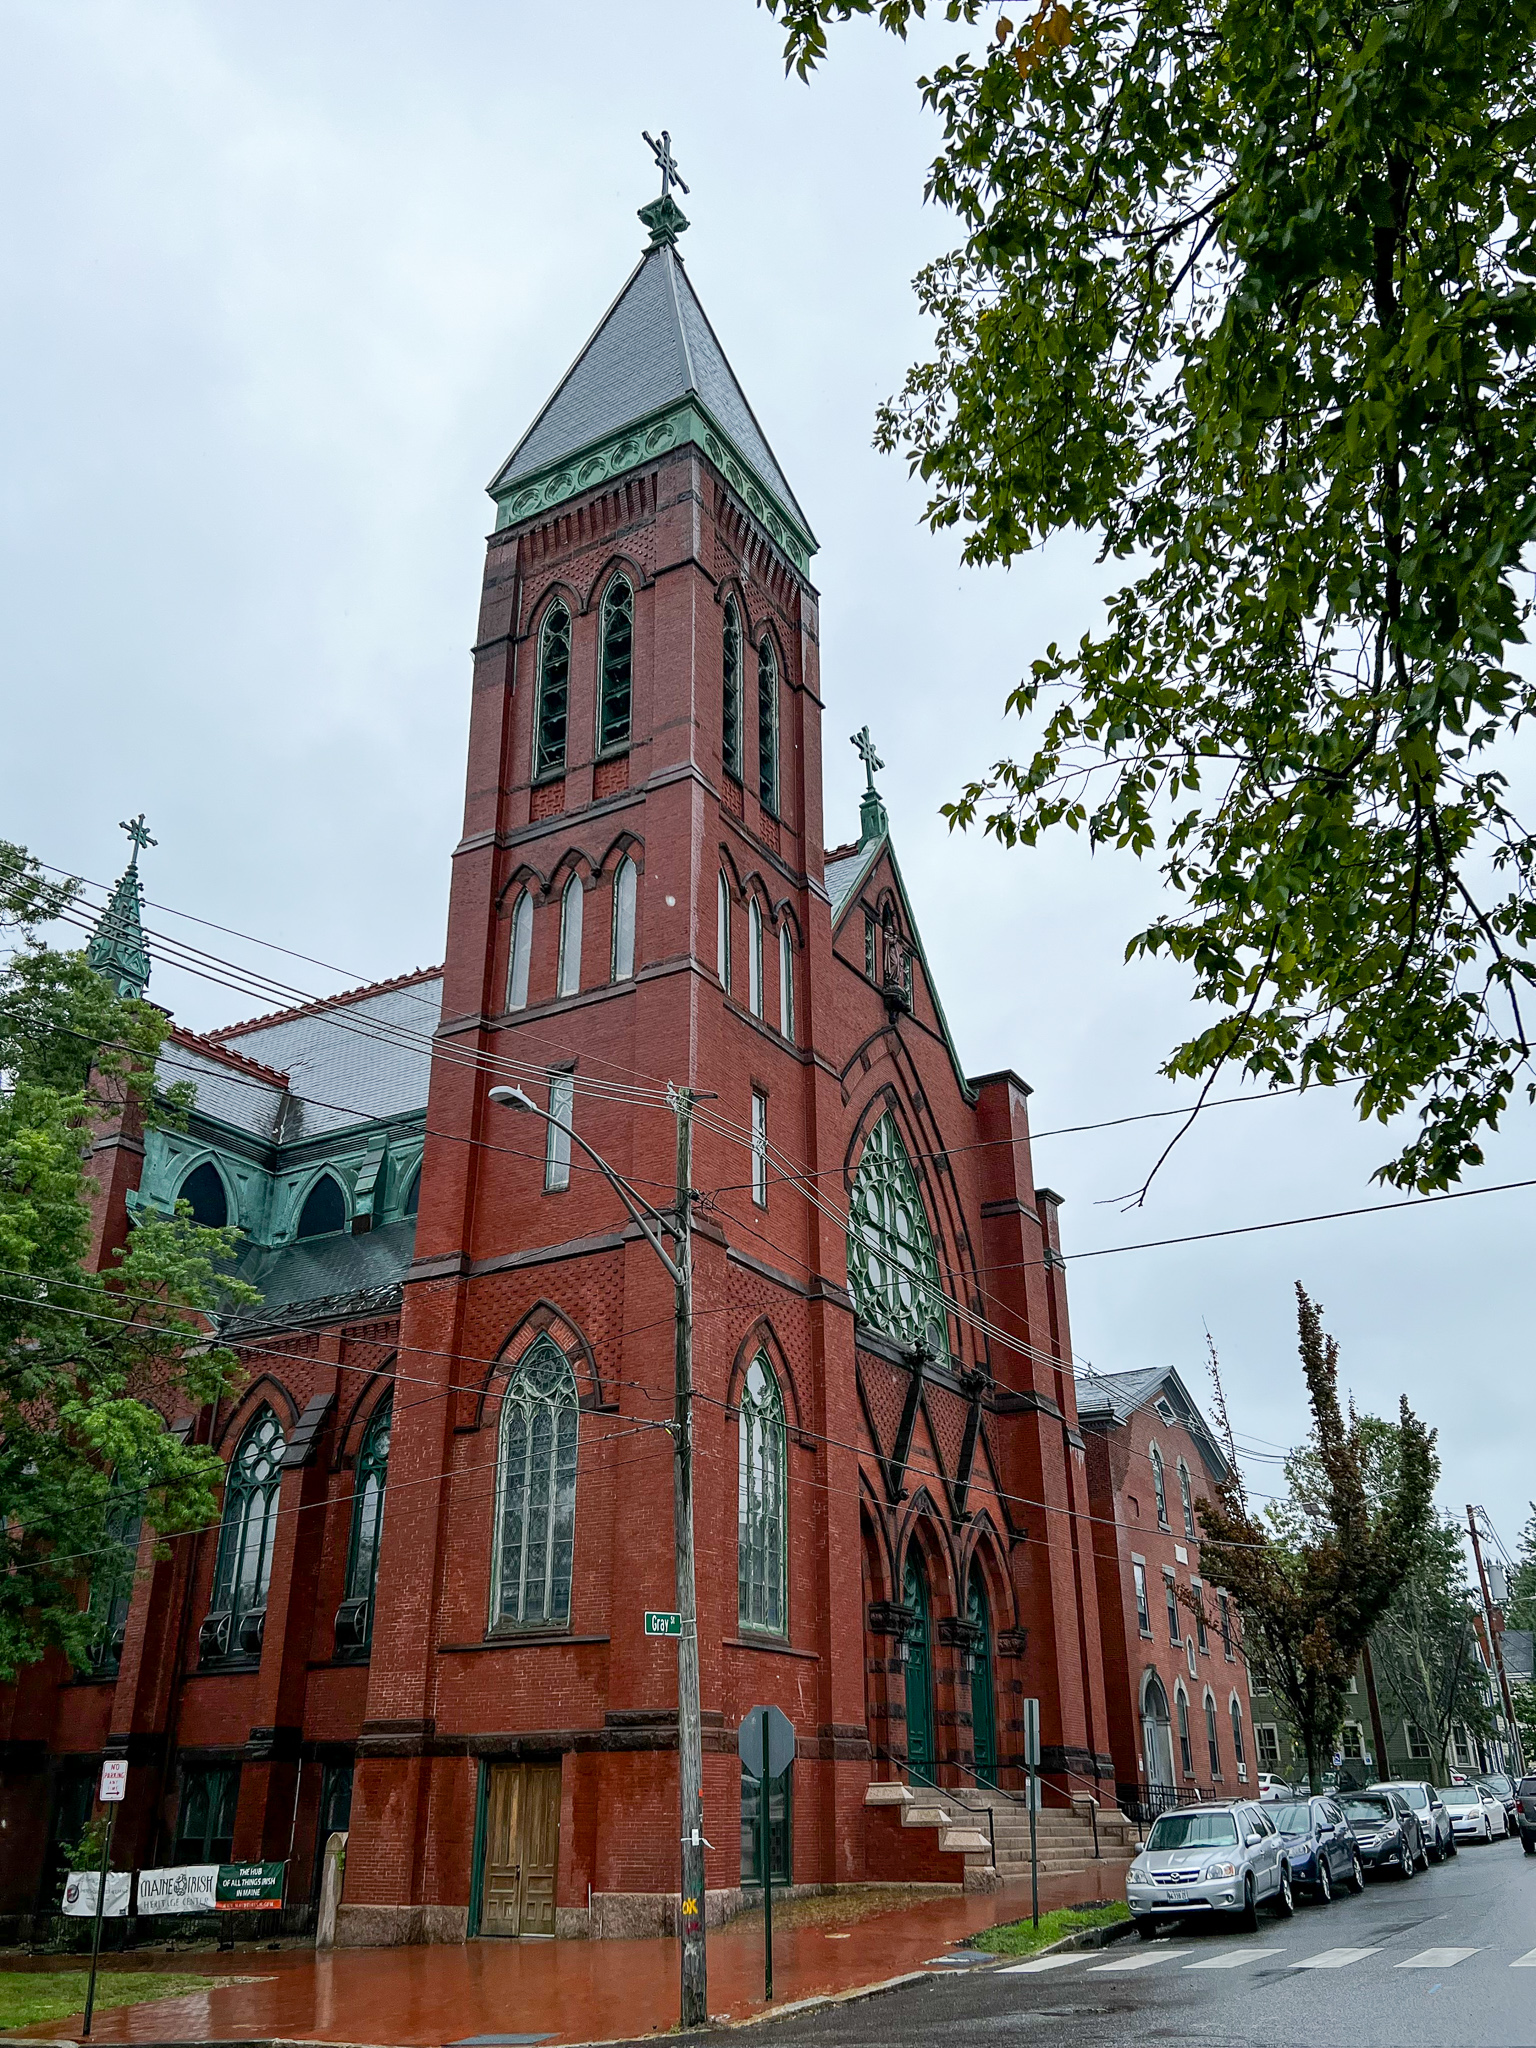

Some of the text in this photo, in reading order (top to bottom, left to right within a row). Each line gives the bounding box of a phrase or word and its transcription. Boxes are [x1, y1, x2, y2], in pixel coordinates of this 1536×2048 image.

[652, 1615, 668, 1632] Gray
[239, 1867, 263, 1876] THE HUB
[140, 1878, 174, 1898] MAINE
[187, 1875, 214, 1894] IRISH
[222, 1877, 276, 1887] OF ALL THINGS IRISH
[236, 1888, 261, 1898] IN MAINE
[143, 1898, 180, 1909] HERITAGE
[682, 1897, 698, 1915] OK
